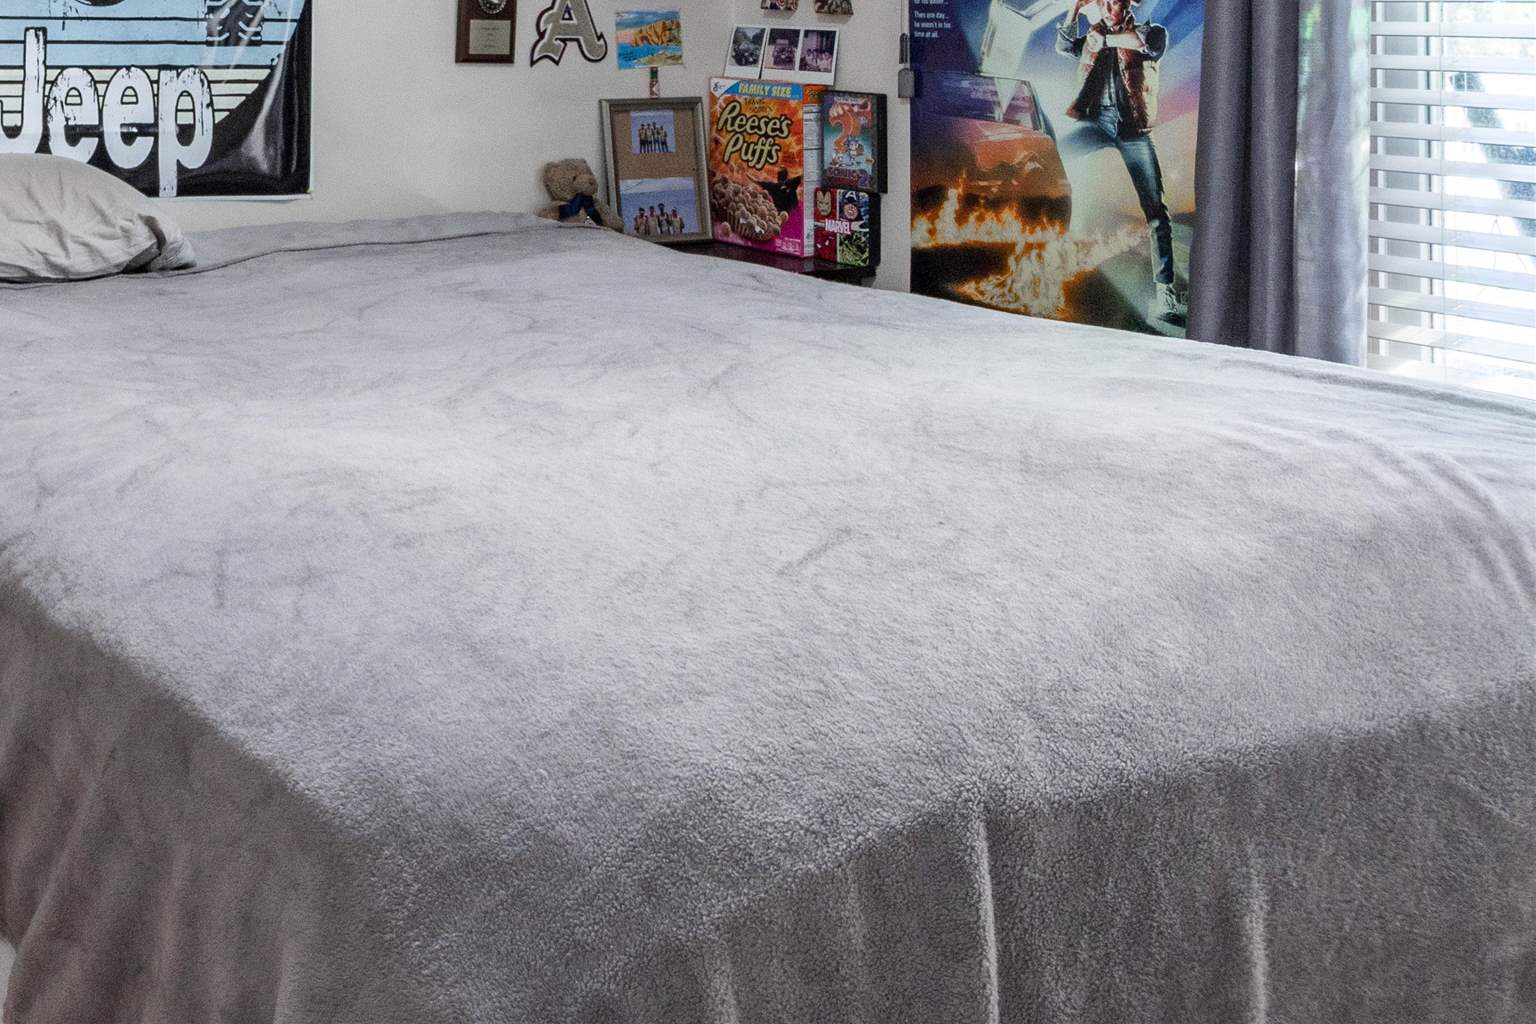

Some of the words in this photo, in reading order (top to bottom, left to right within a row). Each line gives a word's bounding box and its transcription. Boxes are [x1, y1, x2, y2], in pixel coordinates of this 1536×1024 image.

[738, 82, 770, 95] FAMILY
[771, 86, 793, 97] SIZE
[717, 99, 792, 139] Reese's
[723, 132, 782, 170] Puffs
[825, 218, 852, 235] MARVEL
